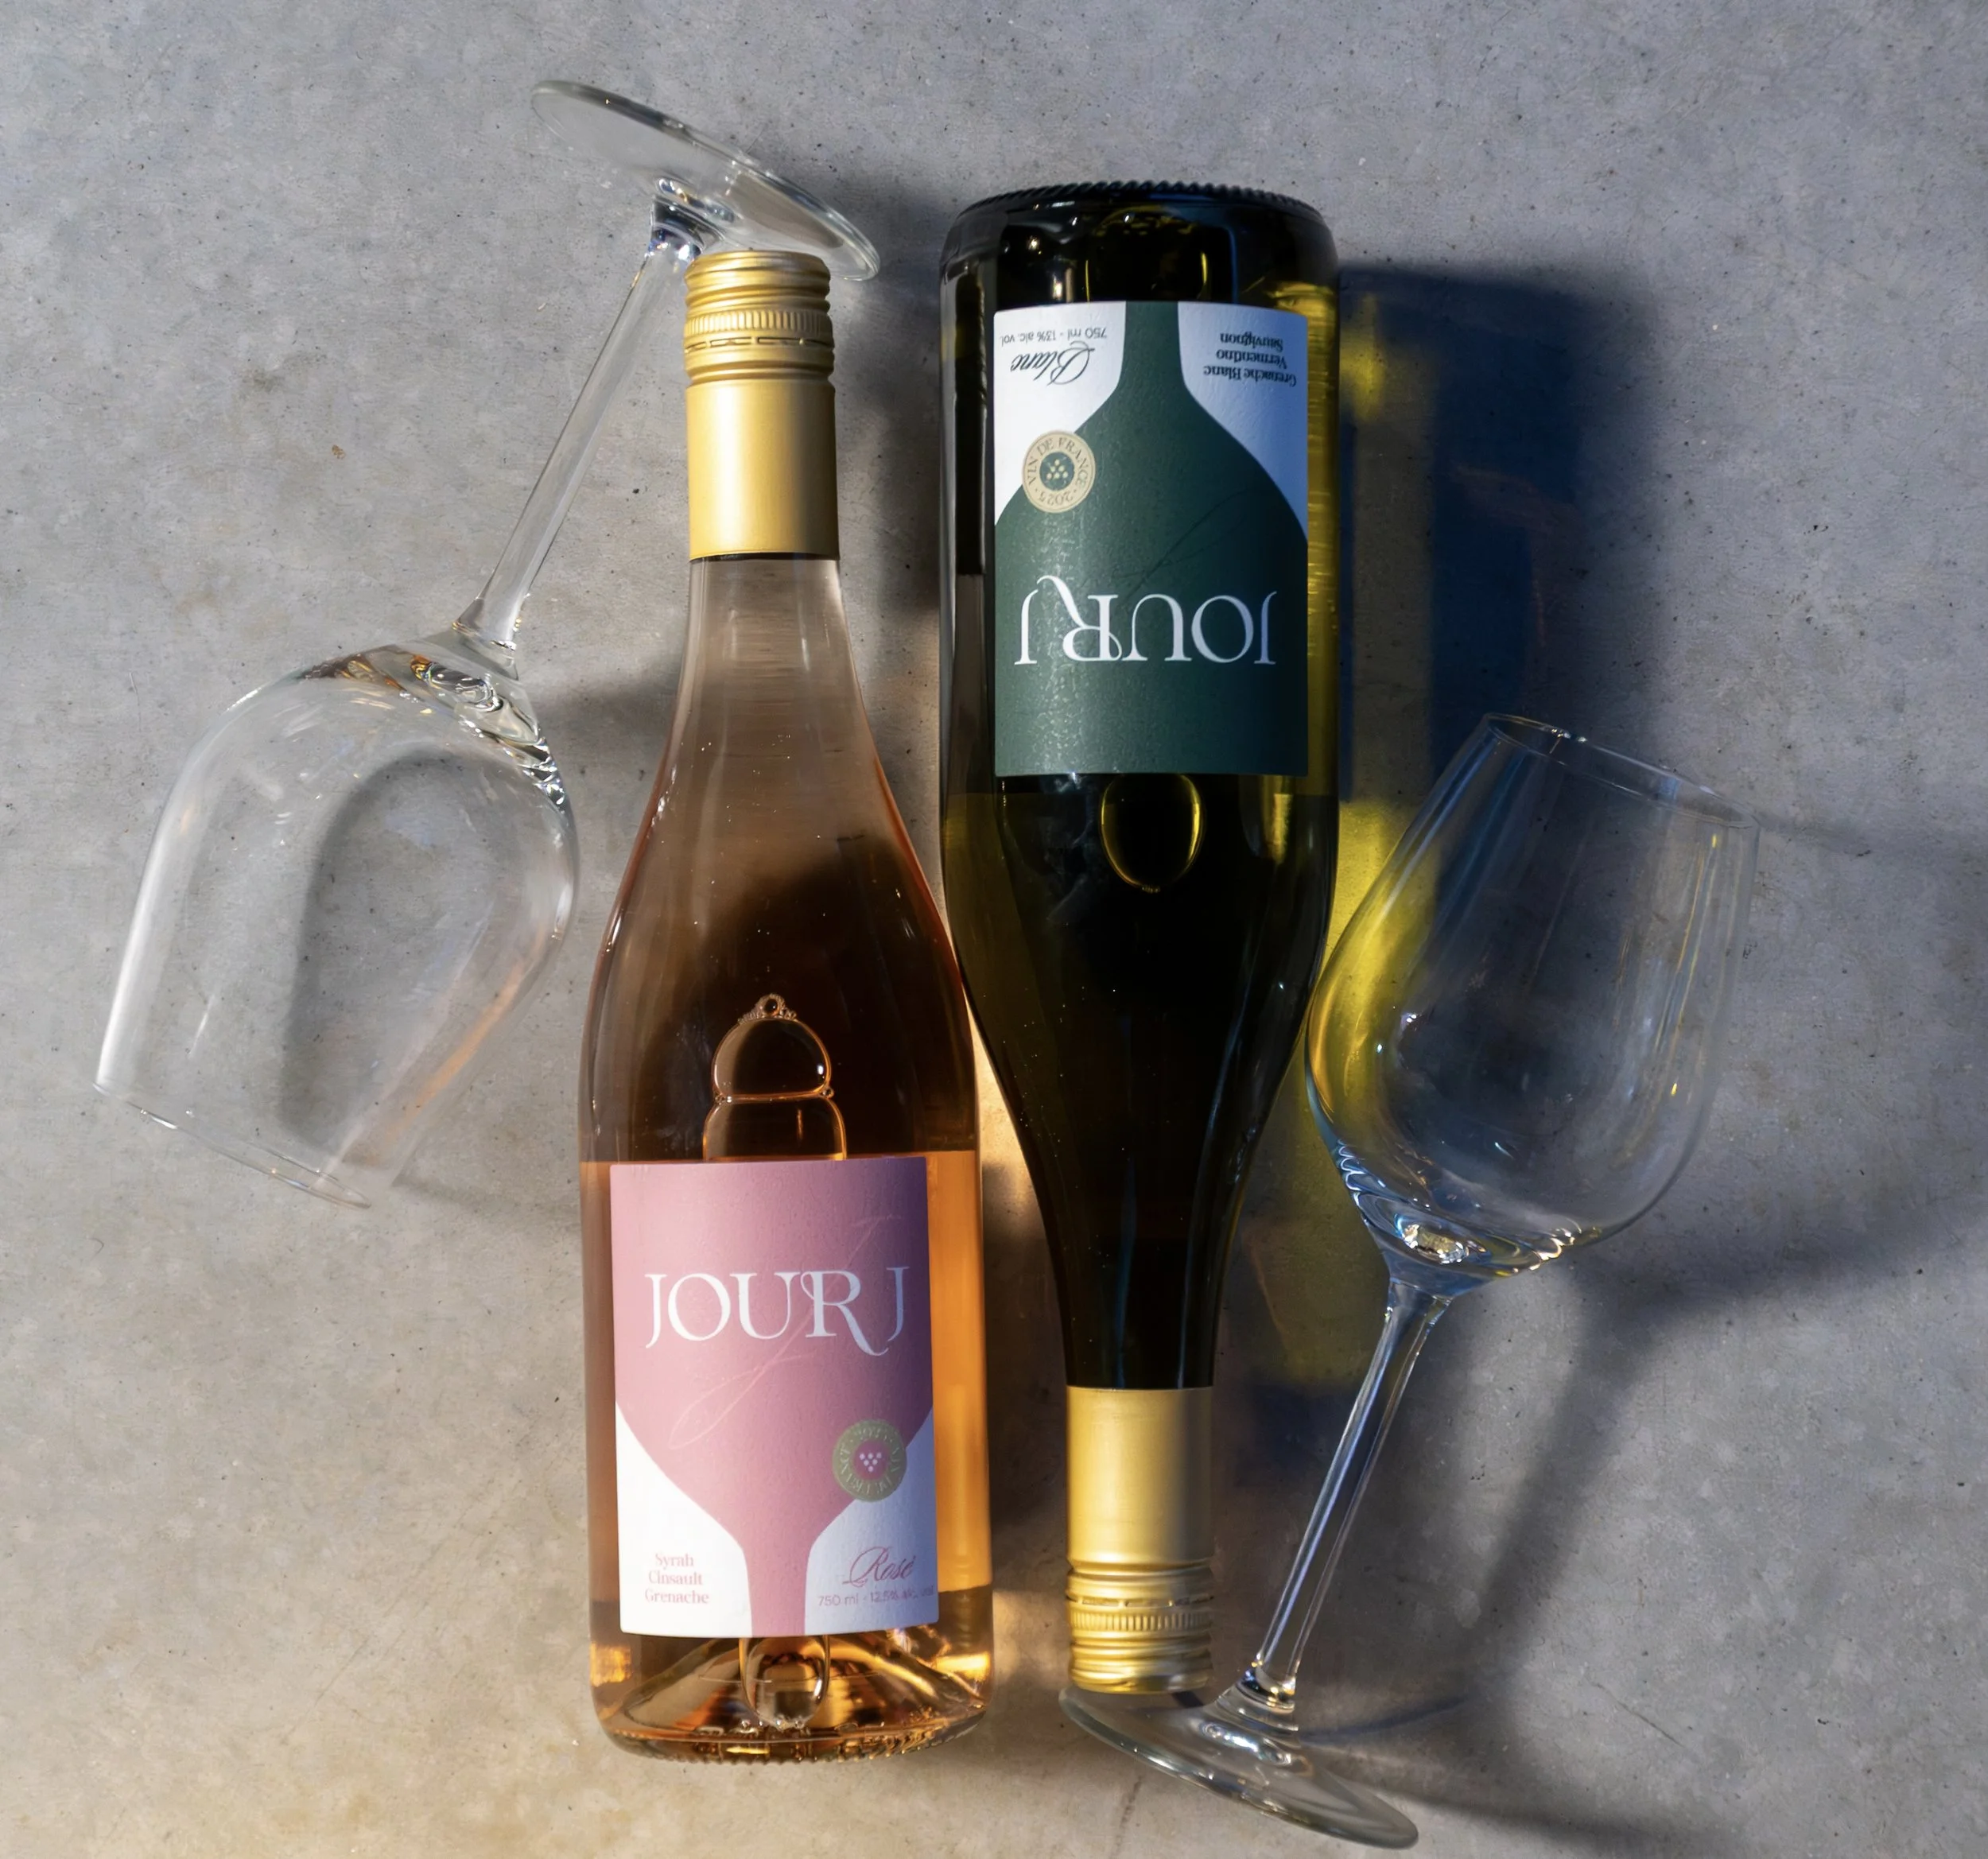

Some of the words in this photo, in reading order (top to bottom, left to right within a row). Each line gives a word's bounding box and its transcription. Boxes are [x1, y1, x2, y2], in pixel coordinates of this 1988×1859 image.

[1036, 330, 1057, 342] 13%
[1067, 328, 1082, 341] ml
[1085, 327, 1108, 340] 750
[1219, 331, 1284, 353] Sauvignon
[1010, 340, 1096, 387] Blanc
[1215, 348, 1288, 371] Vermentino
[1202, 365, 1242, 382] Blanc
[1243, 367, 1297, 388] Grenache
[654, 1550, 695, 1570] Syrah
[841, 1546, 916, 1588] Rosé
[648, 1570, 704, 1585] Cinsault
[644, 1587, 710, 1605] Grenache
[817, 1594, 841, 1607] 750
[845, 1593, 860, 1605] ml
